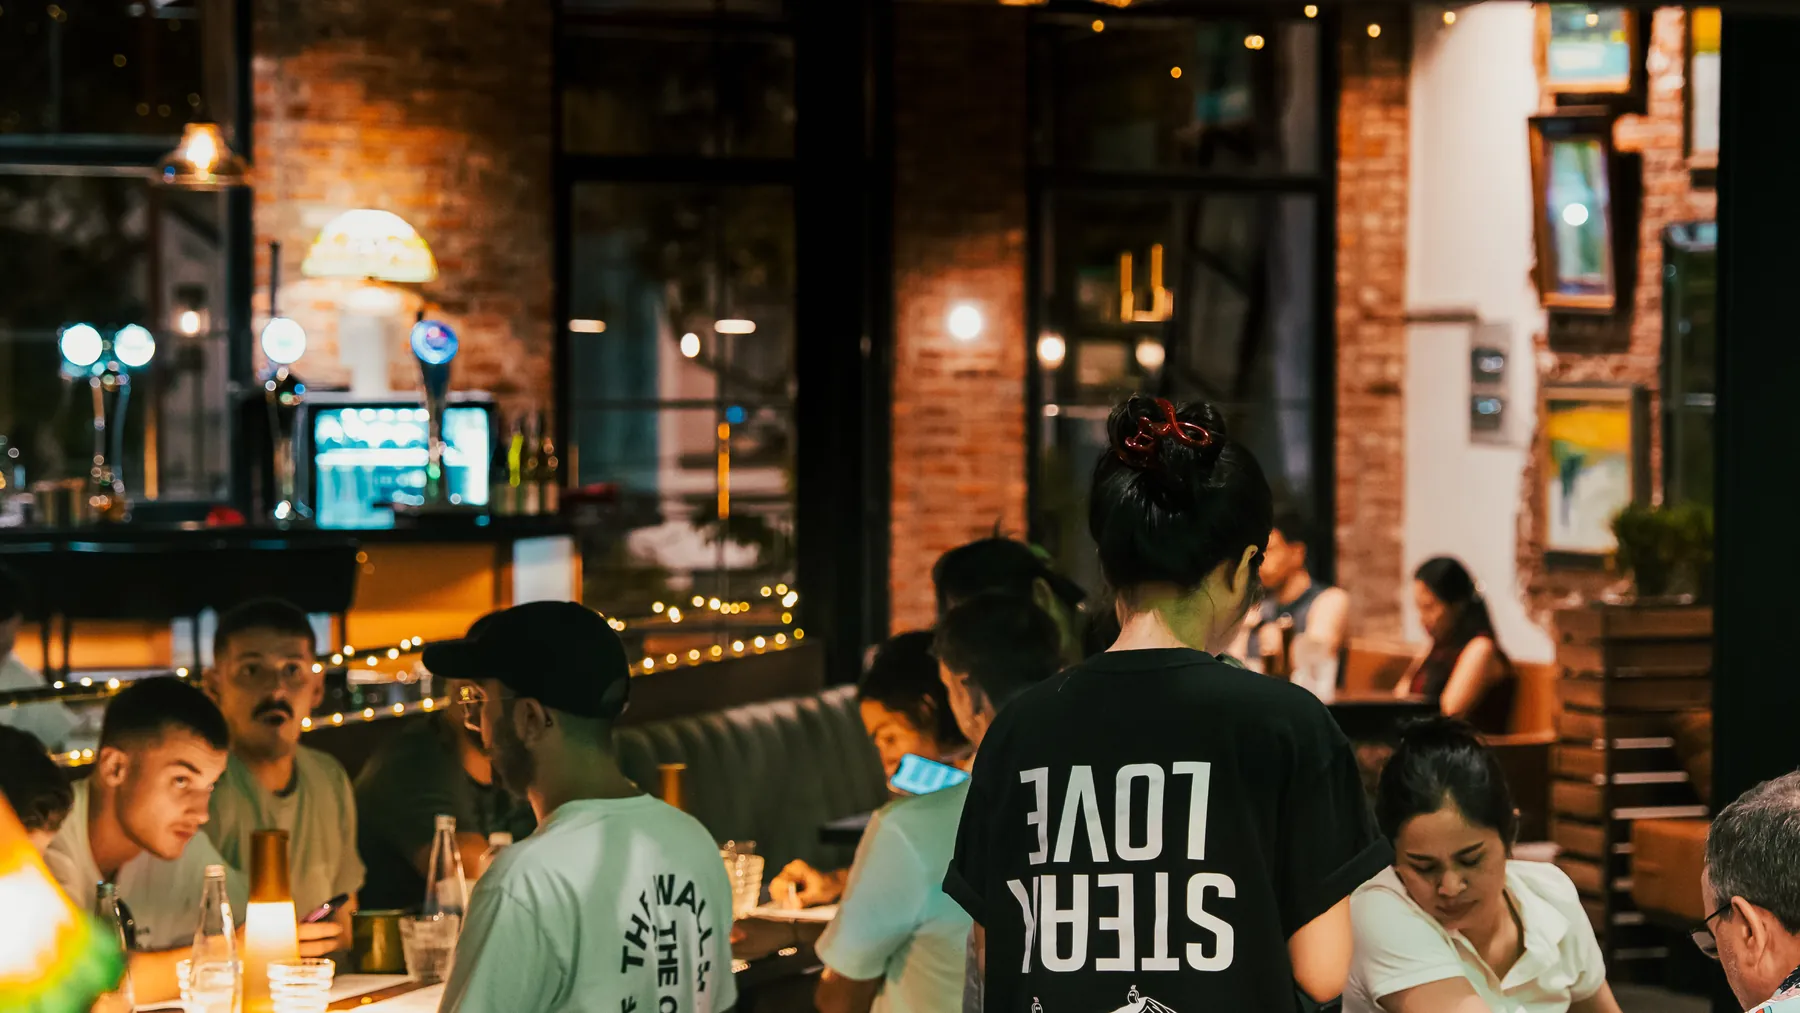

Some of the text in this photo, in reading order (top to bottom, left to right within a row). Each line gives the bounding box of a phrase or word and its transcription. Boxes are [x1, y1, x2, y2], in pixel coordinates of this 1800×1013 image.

[1019, 761, 1211, 865] LOVE
[657, 920, 679, 988] THE
[1006, 872, 1236, 974] STEAK
